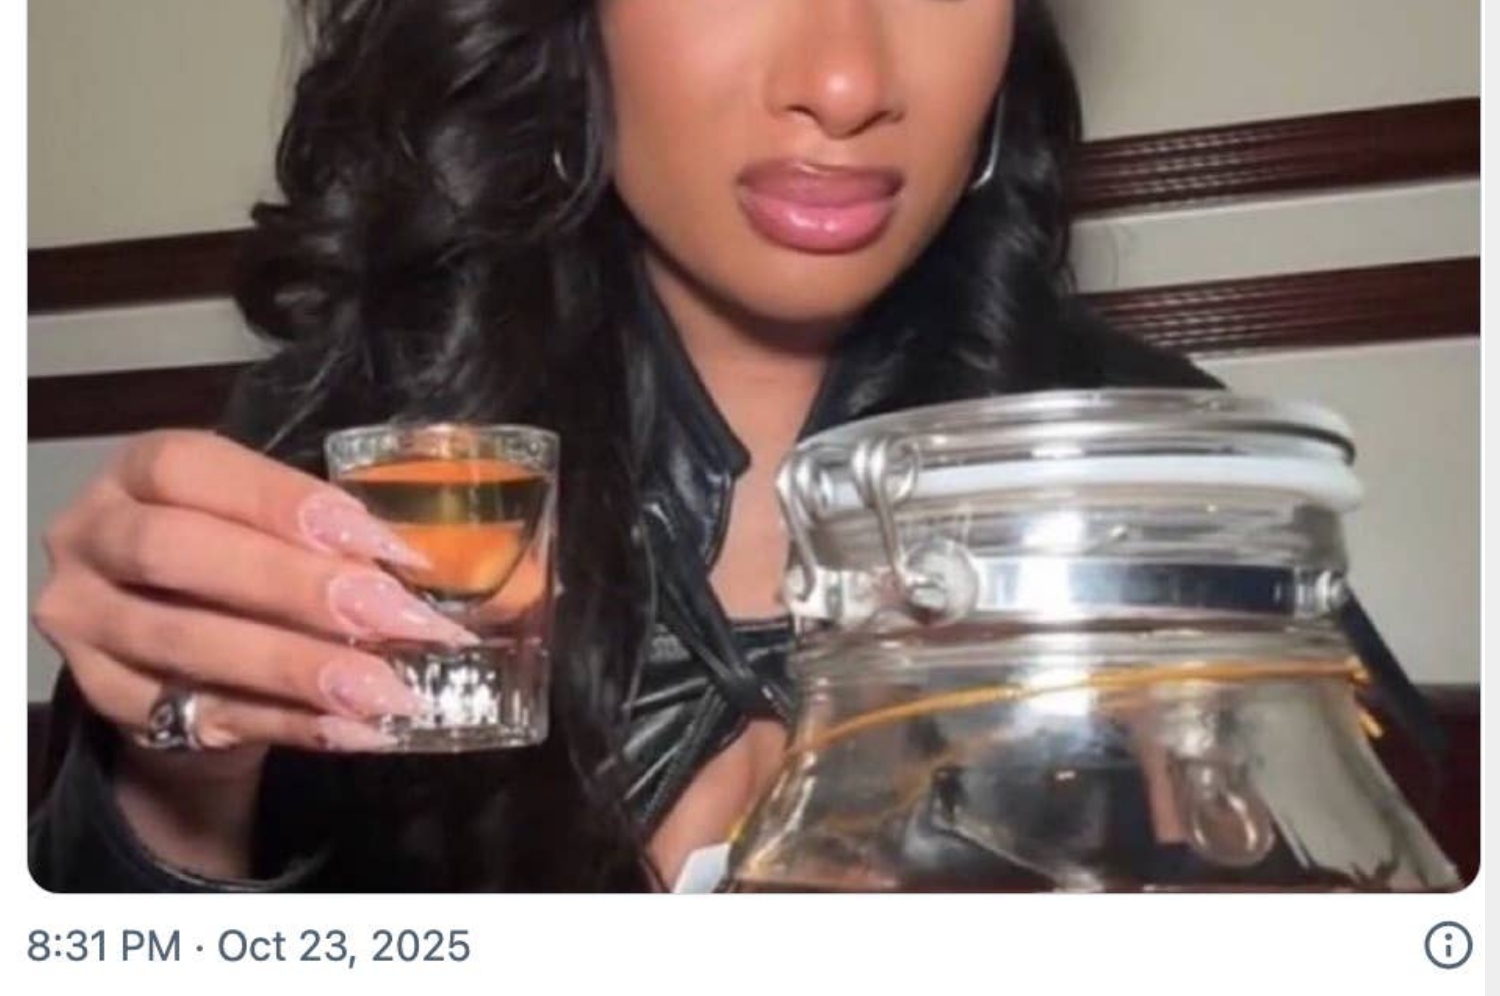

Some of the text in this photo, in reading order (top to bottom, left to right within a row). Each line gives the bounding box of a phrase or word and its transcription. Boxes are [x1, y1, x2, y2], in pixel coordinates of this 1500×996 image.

[27, 928, 471, 970] 8:31 PM Oct 23, 2025
